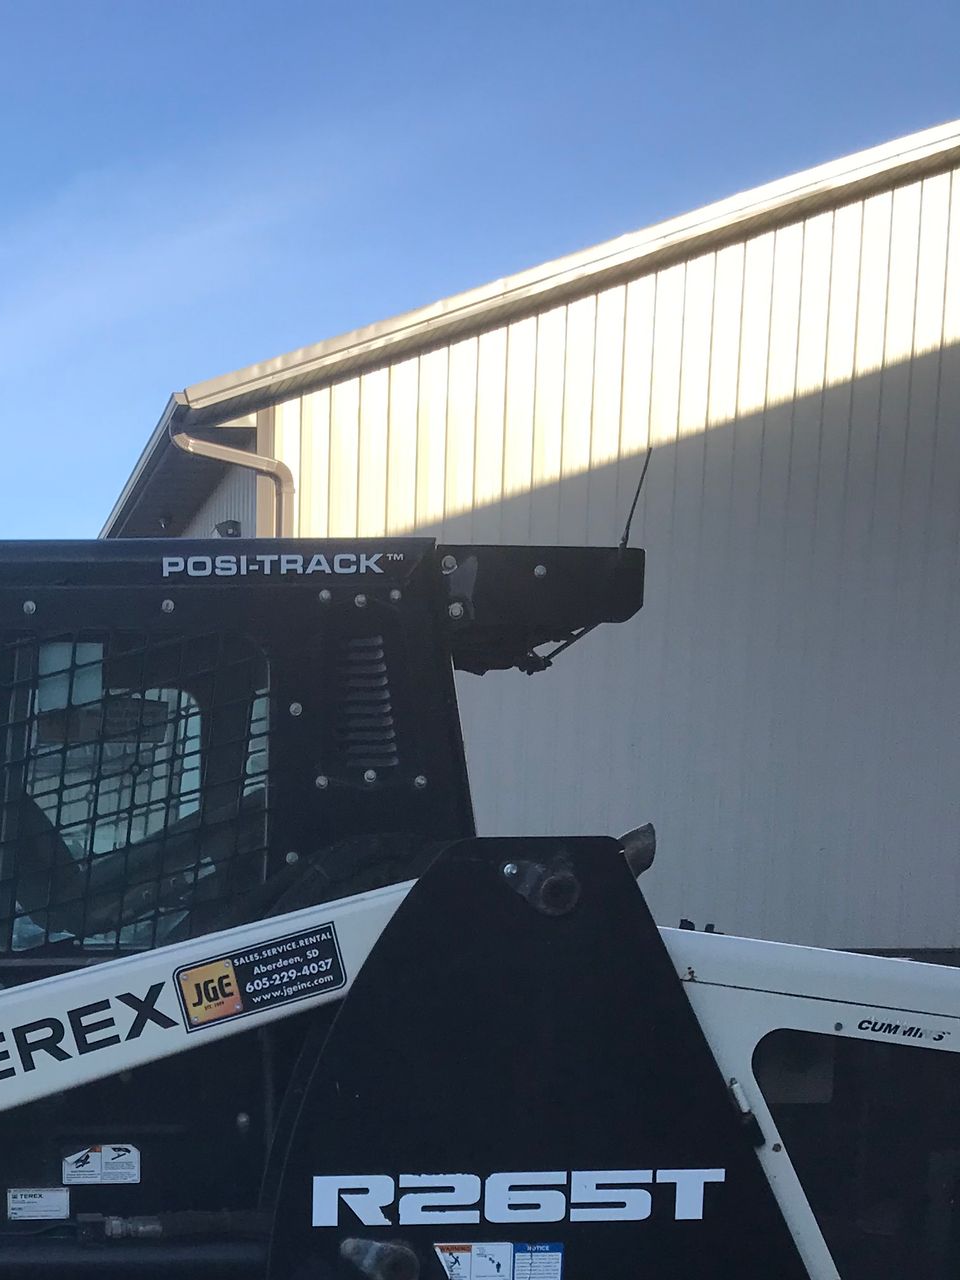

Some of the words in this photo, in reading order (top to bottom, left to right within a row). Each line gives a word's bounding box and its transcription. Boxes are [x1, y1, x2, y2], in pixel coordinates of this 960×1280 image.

[233, 932, 332, 967] SALES.SERVICE.RENTAL
[253, 954, 304, 975] Aberdeen,
[306, 949, 319, 960] SD
[192, 974, 234, 1008] JGE
[245, 958, 333, 993] 605-229-4037
[252, 974, 334, 1004] www.jgeinc.com
[312, 1168, 726, 1227] R265T
